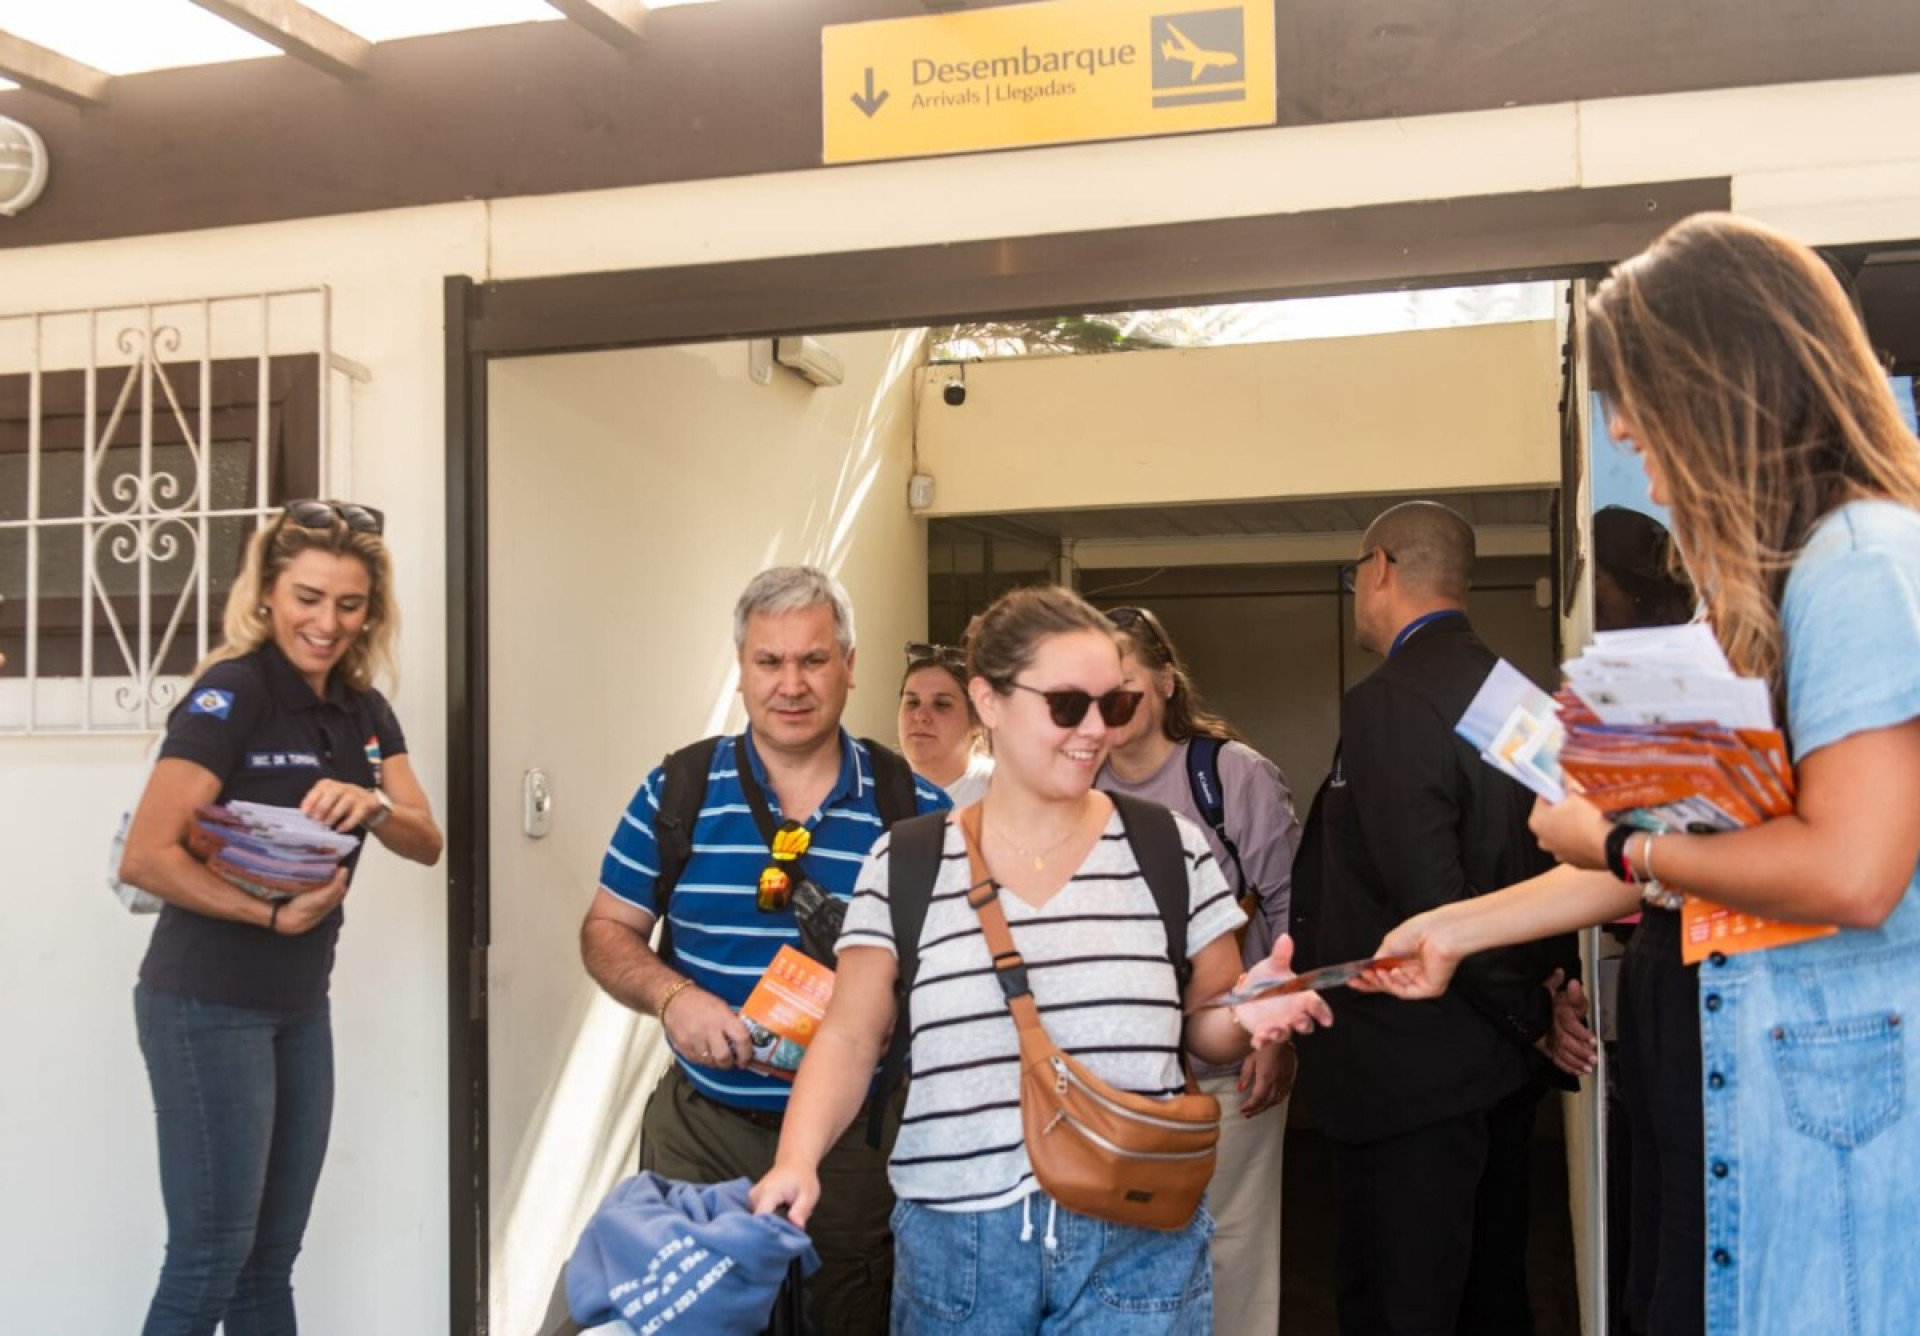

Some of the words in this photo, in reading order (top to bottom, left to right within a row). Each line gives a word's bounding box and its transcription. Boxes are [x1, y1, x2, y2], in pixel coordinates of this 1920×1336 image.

[911, 44, 1137, 86] Desembarque
[911, 88, 980, 110] Arrivals
[995, 80, 1077, 104] Llegadas
